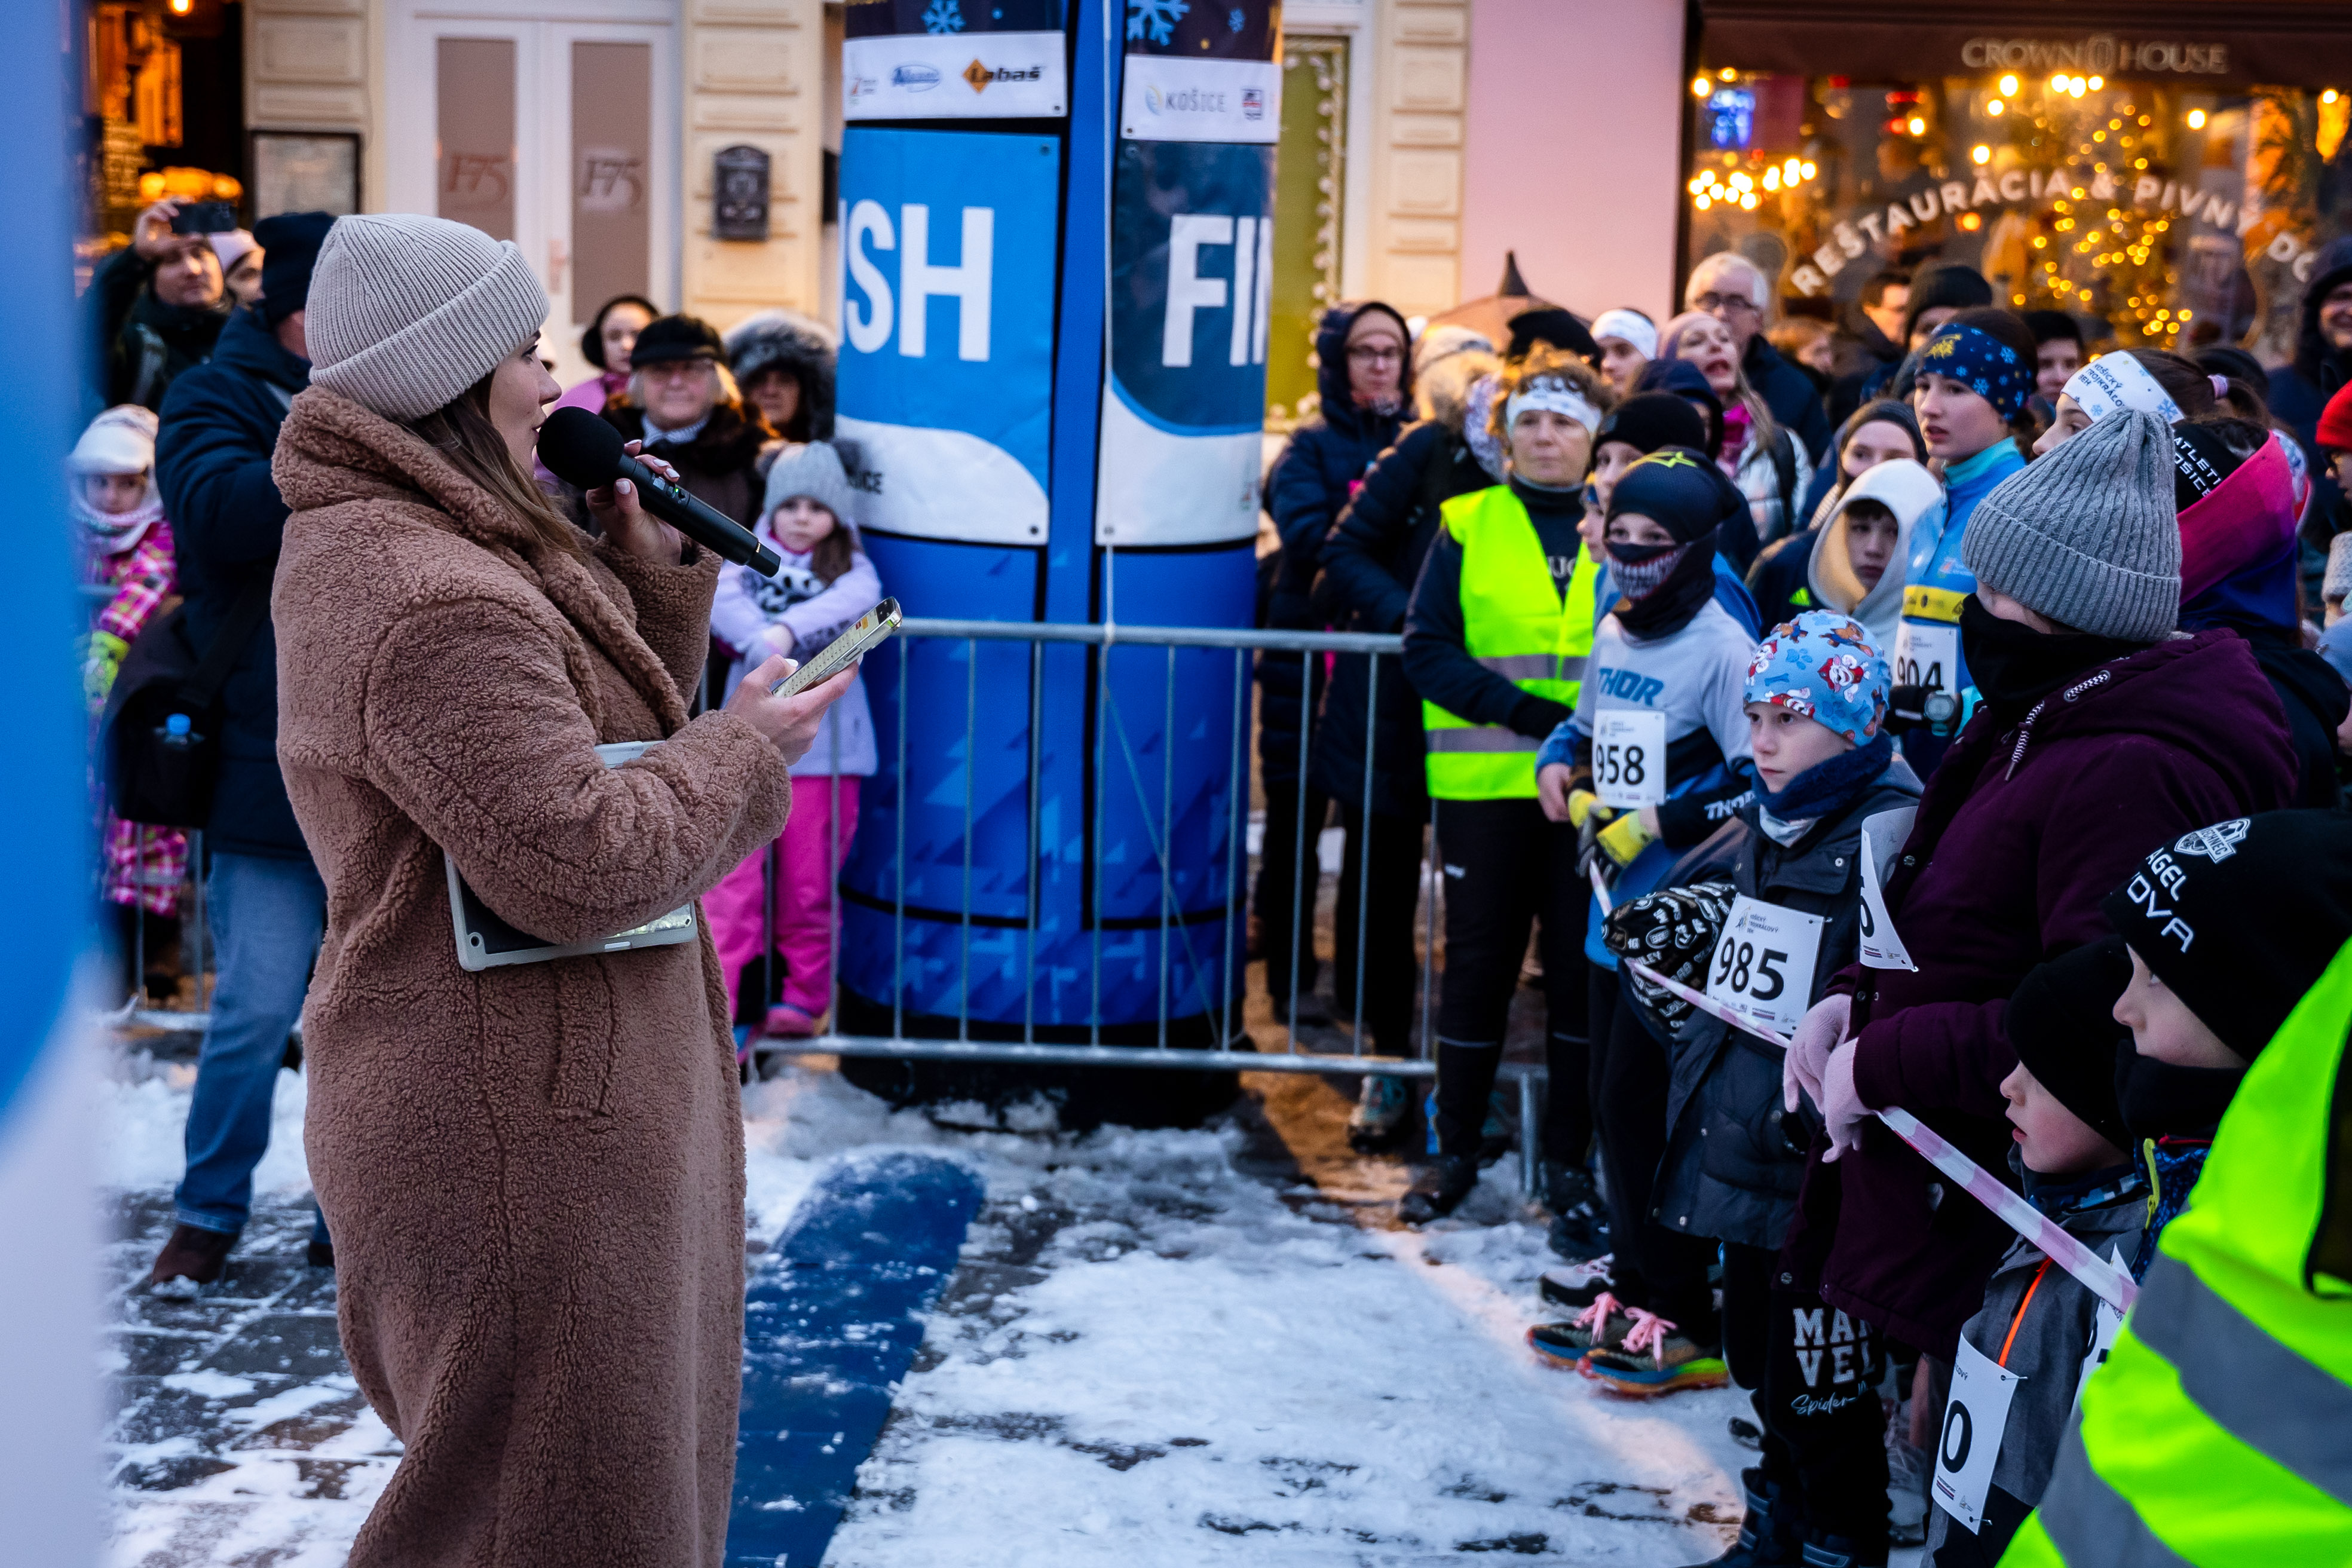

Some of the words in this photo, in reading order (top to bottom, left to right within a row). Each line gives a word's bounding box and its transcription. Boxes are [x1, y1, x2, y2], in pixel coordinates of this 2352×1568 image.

[1962, 37, 2083, 68] CROWN
[2120, 41, 2228, 74] HOUSE
[1598, 667, 1664, 707] THOR
[1897, 656, 1944, 691] 904
[1596, 744, 1644, 786] 958
[1714, 936, 1788, 1001] 985
[1796, 1340, 1876, 1387] VEL
[1941, 1399, 1973, 1474] 0
